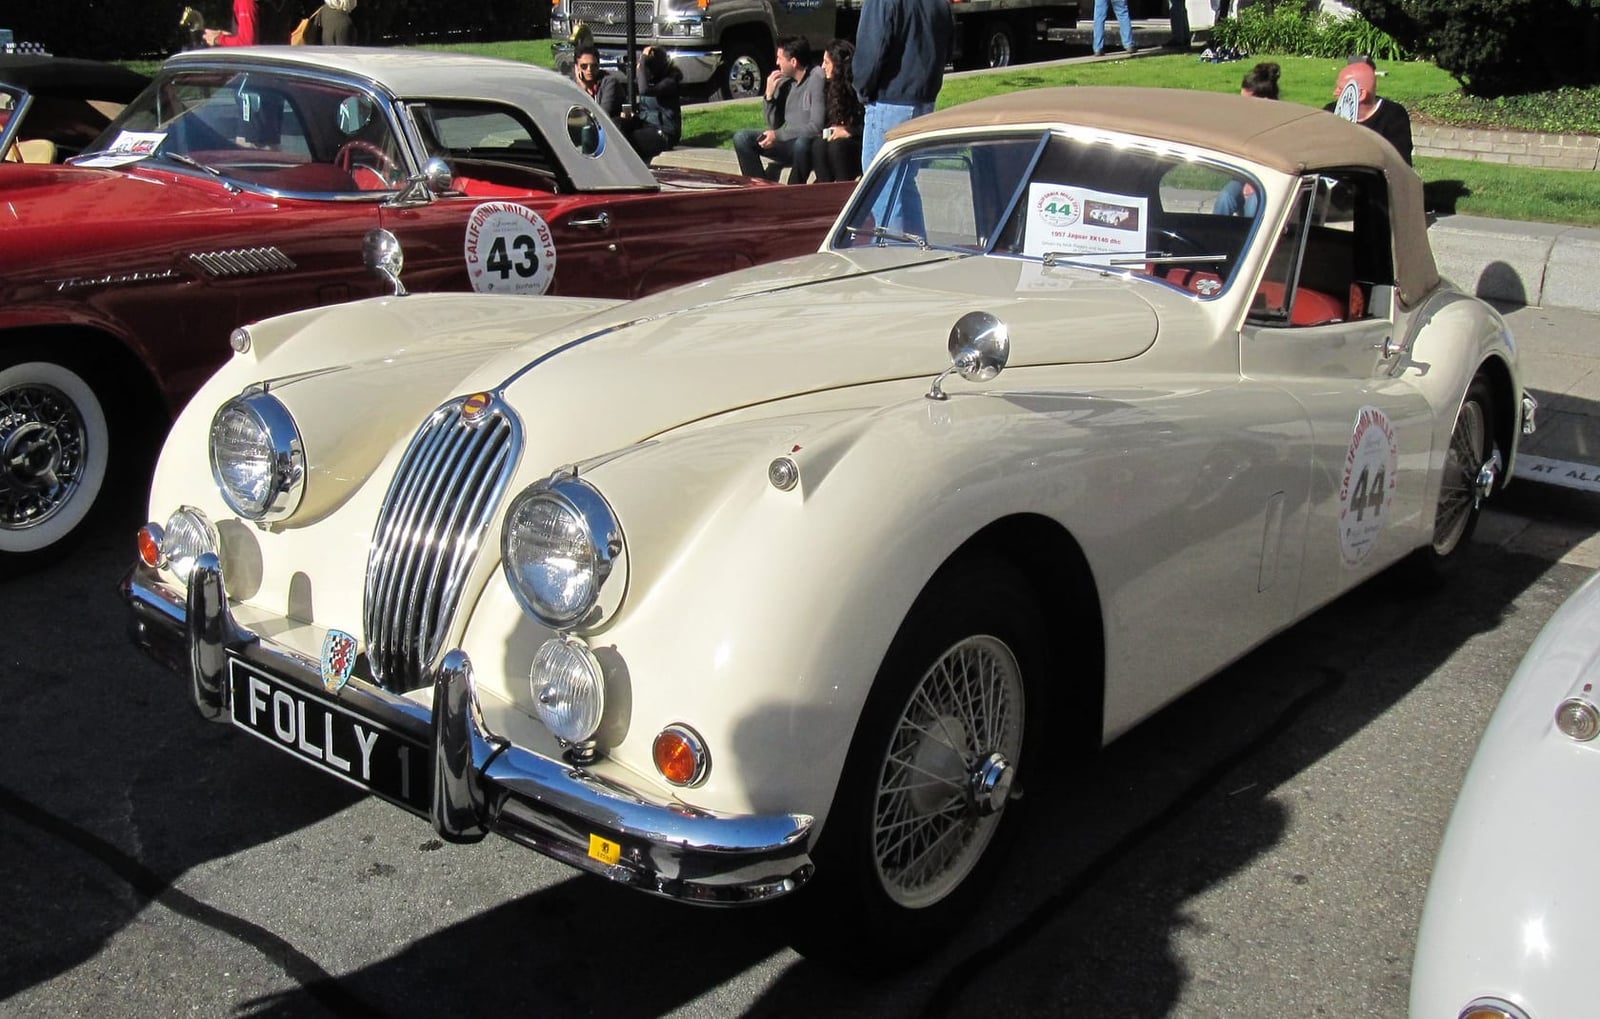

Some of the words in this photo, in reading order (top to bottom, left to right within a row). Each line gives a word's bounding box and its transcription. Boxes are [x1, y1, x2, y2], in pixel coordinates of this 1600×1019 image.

[467, 204, 501, 264] CALIFORNIA
[502, 204, 538, 225] MILLE
[537, 225, 554, 258] 2014
[1044, 202, 1071, 216] 44
[1067, 232, 1088, 241] Jaguar
[486, 234, 540, 280] 43
[1340, 408, 1372, 501] CALIFORNIA
[1371, 409, 1394, 445] MILLE
[1350, 464, 1385, 522] 44
[249, 675, 379, 780] FOLLY
[398, 745, 410, 799] 1
